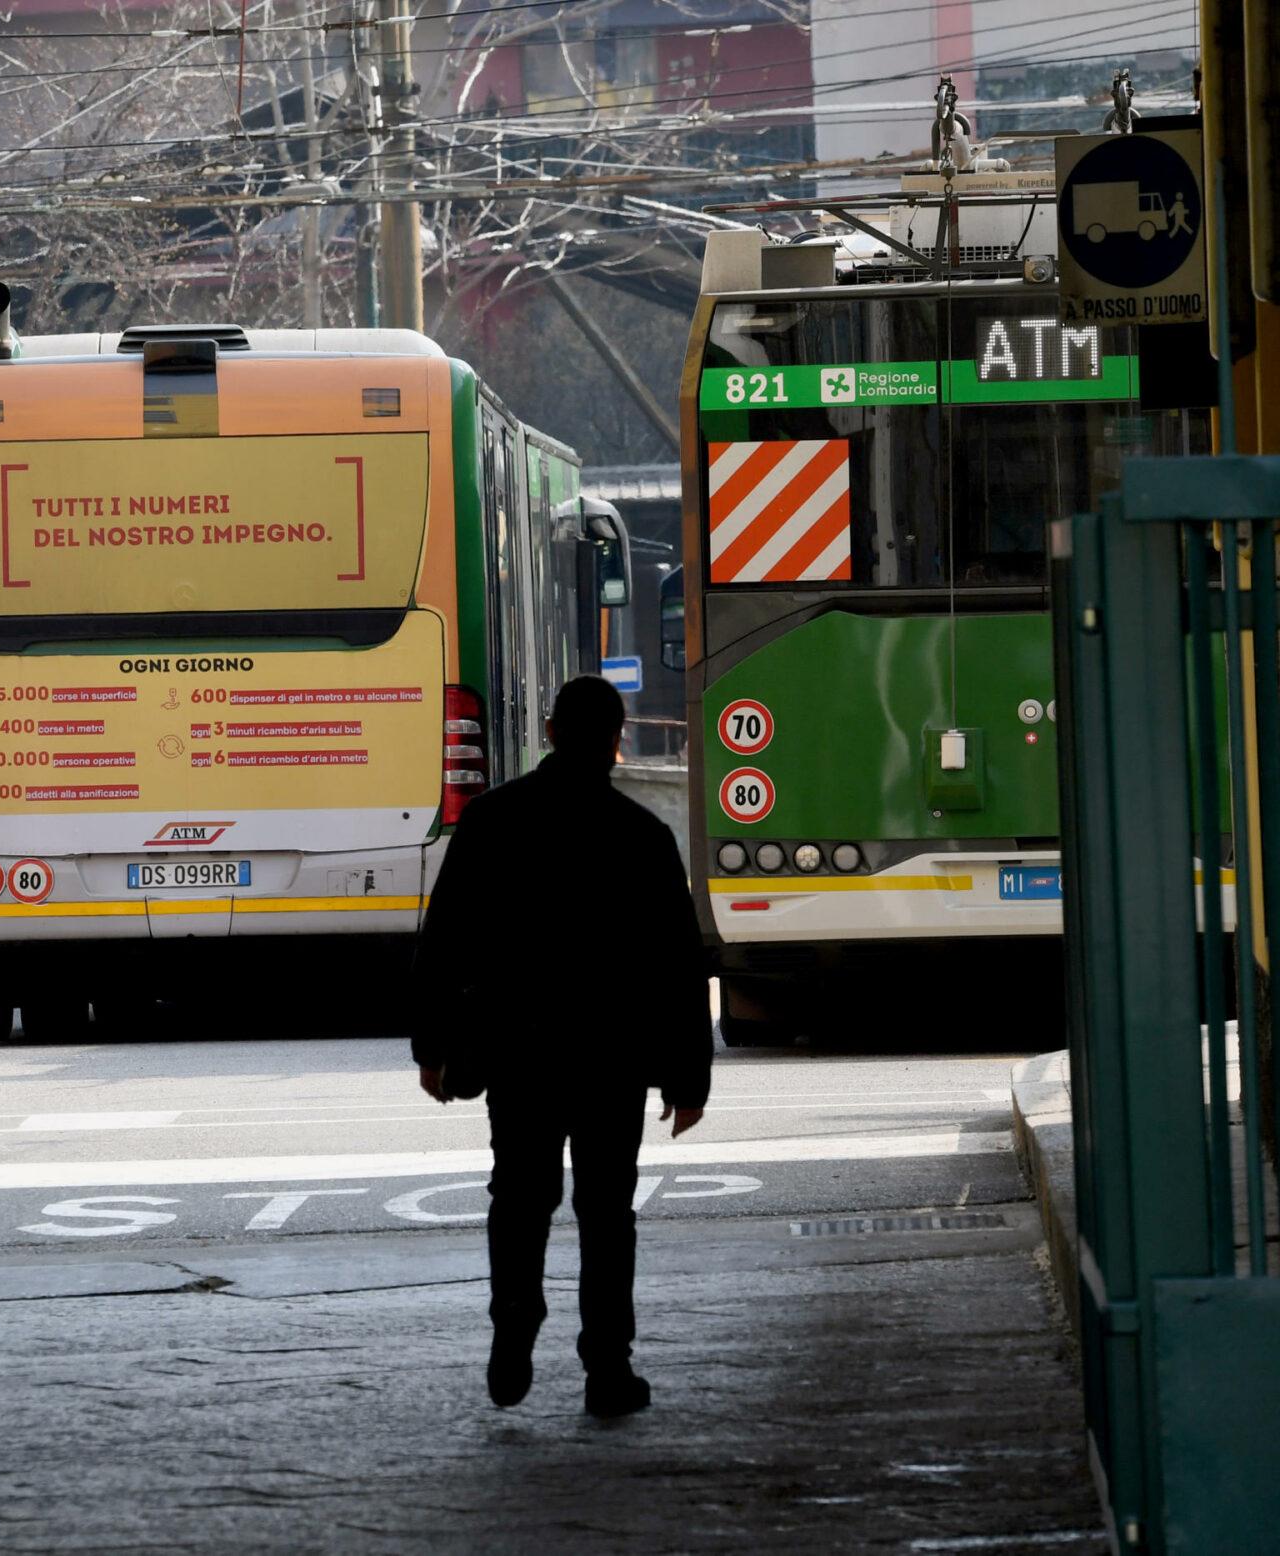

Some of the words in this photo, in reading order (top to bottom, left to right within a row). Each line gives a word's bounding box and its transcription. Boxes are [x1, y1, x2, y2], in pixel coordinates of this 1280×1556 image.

[1066, 302, 1077, 319] A
[1084, 297, 1137, 319] PASSO
[1144, 293, 1201, 317] D'UOMO
[980, 320, 1098, 379] ATM
[859, 371, 920, 384] Regione
[726, 372, 789, 404] 821
[859, 384, 937, 396] Lombardia
[32, 498, 104, 517] TUTTI
[111, 498, 121, 516] I
[129, 495, 231, 515] NUMERI
[34, 528, 80, 547] DEL
[89, 525, 195, 546] NOSTRO
[202, 522, 333, 545] IMPEGNO.
[119, 659, 170, 673] OGNI
[175, 657, 254, 673] GIORNO
[52, 693, 78, 701] corse
[80, 692, 89, 700] in
[91, 690, 137, 701] superficie
[191, 688, 227, 704] 600
[230, 695, 275, 705] dispenser
[278, 693, 286, 702] di
[288, 693, 303, 704] gel
[305, 693, 314, 702] in
[316, 692, 343, 701] metro
[353, 692, 365, 701] su
[367, 691, 398, 700] alcune
[400, 690, 422, 699] linee
[66, 724, 75, 733] in
[77, 724, 105, 732] metro
[191, 729, 211, 738] ogni
[214, 721, 224, 736] 3
[227, 727, 255, 736] minuti
[257, 725, 298, 735] ricambio
[300, 725, 326, 734] d'aria
[344, 725, 362, 734] bus
[732, 714, 761, 740] 70
[52, 757, 91, 768] persone
[93, 756, 136, 767] operative
[191, 757, 212, 767] ogni
[214, 750, 225, 765] 6
[228, 755, 256, 764] minuti
[258, 754, 300, 763] ricambio
[302, 754, 328, 763] d'aria
[329, 753, 339, 762] in
[340, 753, 368, 762] metro
[25, 791, 58, 799] addetti
[60, 790, 77, 798] alla
[79, 788, 139, 798] sanificazione
[735, 784, 760, 806] 80
[170, 827, 206, 839] ATM
[19, 871, 42, 890] 80
[142, 866, 166, 886] DS
[174, 864, 237, 885] 099RR
[1003, 873, 1023, 893] MI
[19, 1175, 763, 1237] STOP
